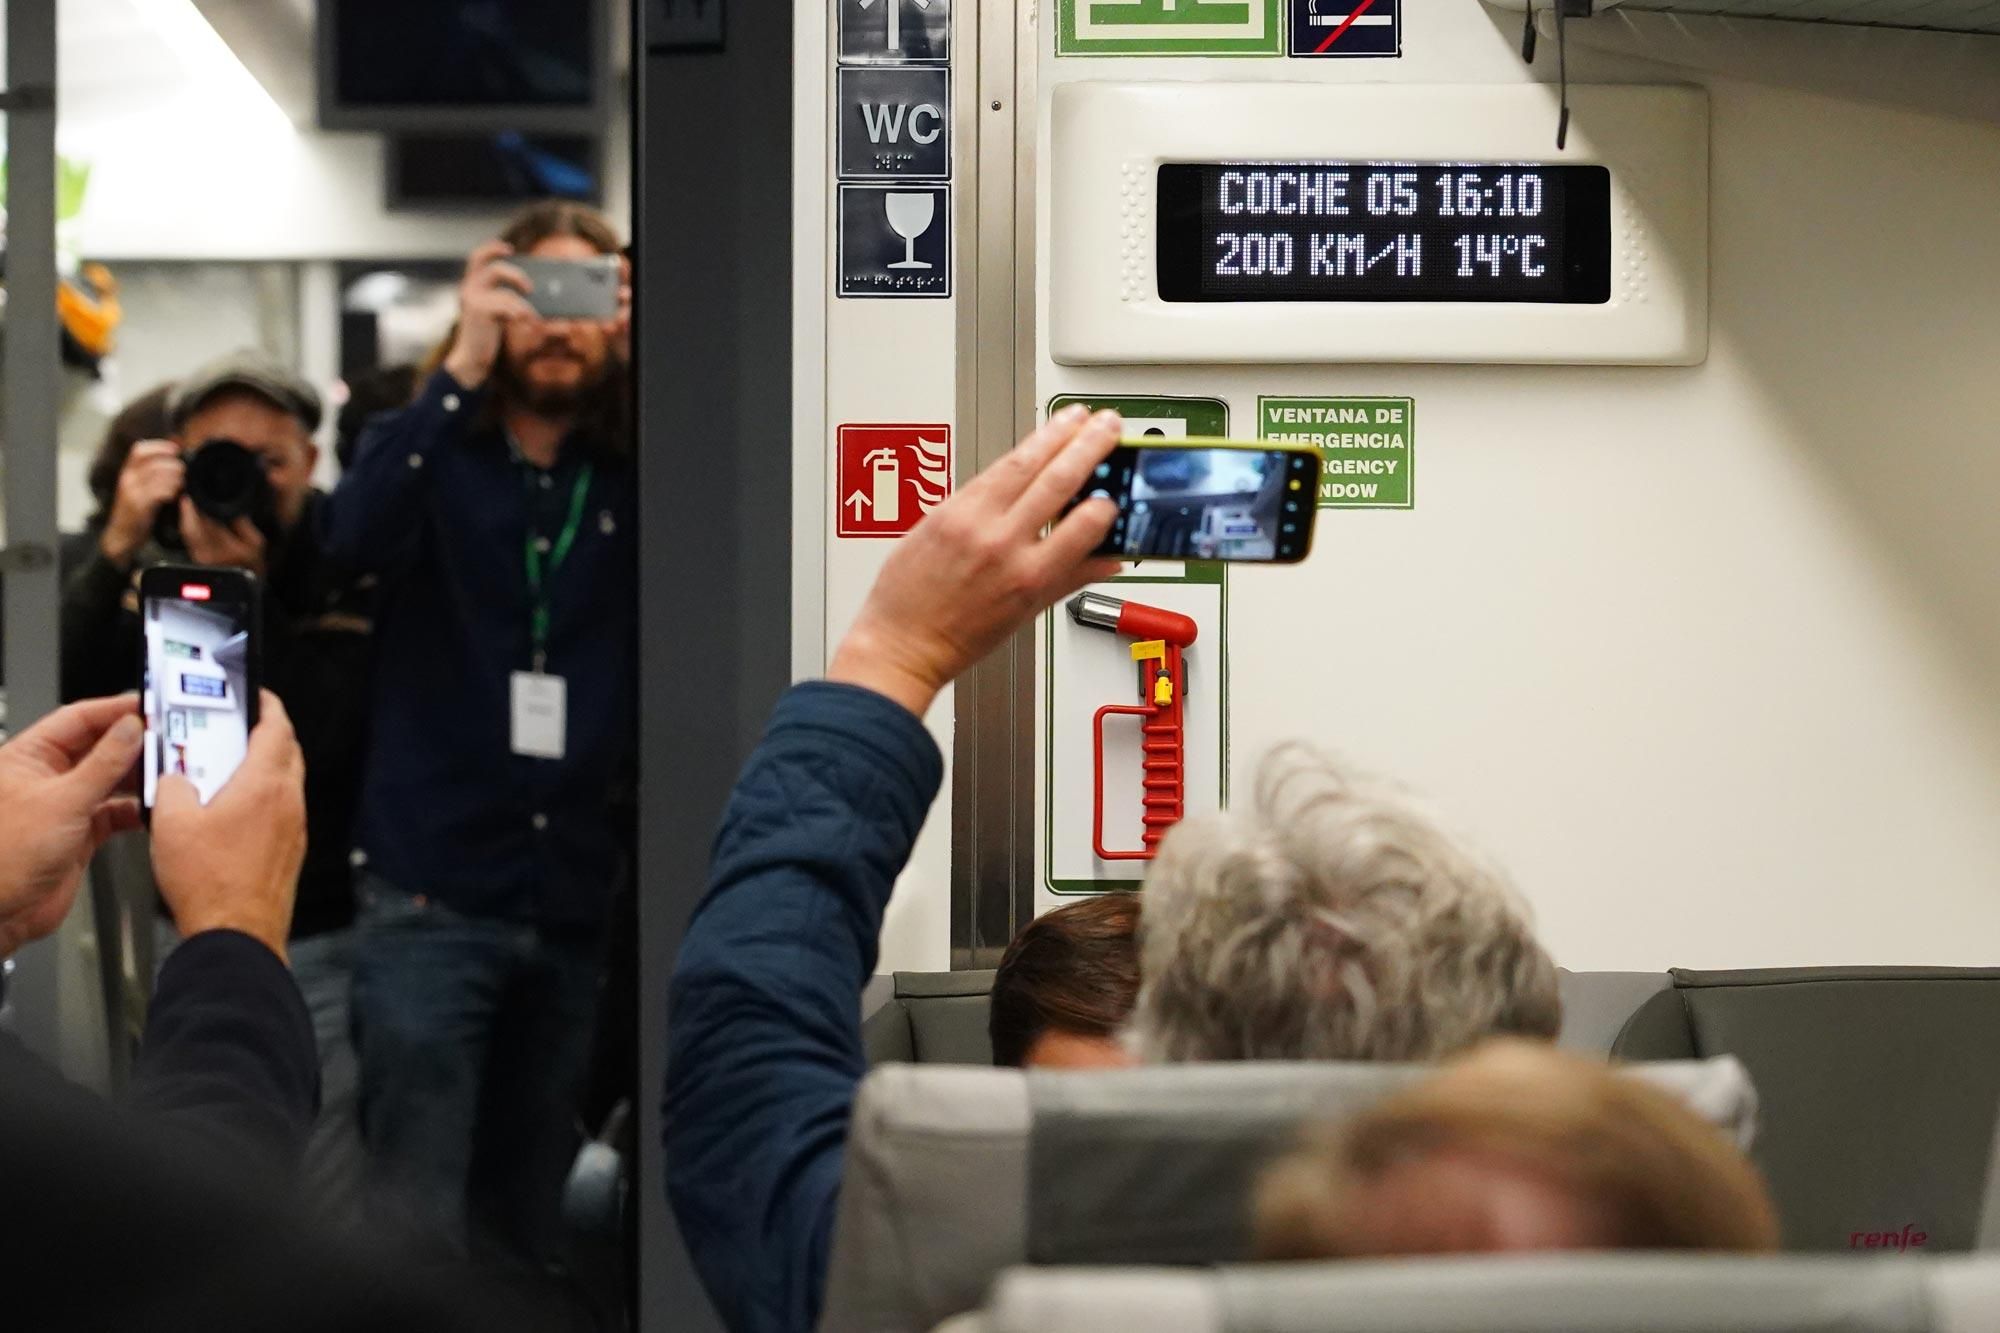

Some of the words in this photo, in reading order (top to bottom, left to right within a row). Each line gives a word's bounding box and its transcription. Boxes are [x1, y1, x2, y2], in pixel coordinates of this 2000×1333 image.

[861, 103, 941, 145] WC
[1220, 172, 1350, 215] COCHE
[1367, 173, 1418, 215] 05
[1435, 173, 1542, 216] 16:10
[1216, 233, 1293, 275] 200
[1310, 233, 1421, 276] KM/H
[1268, 408, 1369, 424] VENTANA
[1375, 408, 1403, 424] DE
[1319, 483, 1378, 498] NDOW
[1849, 1223, 1927, 1253] renfe
